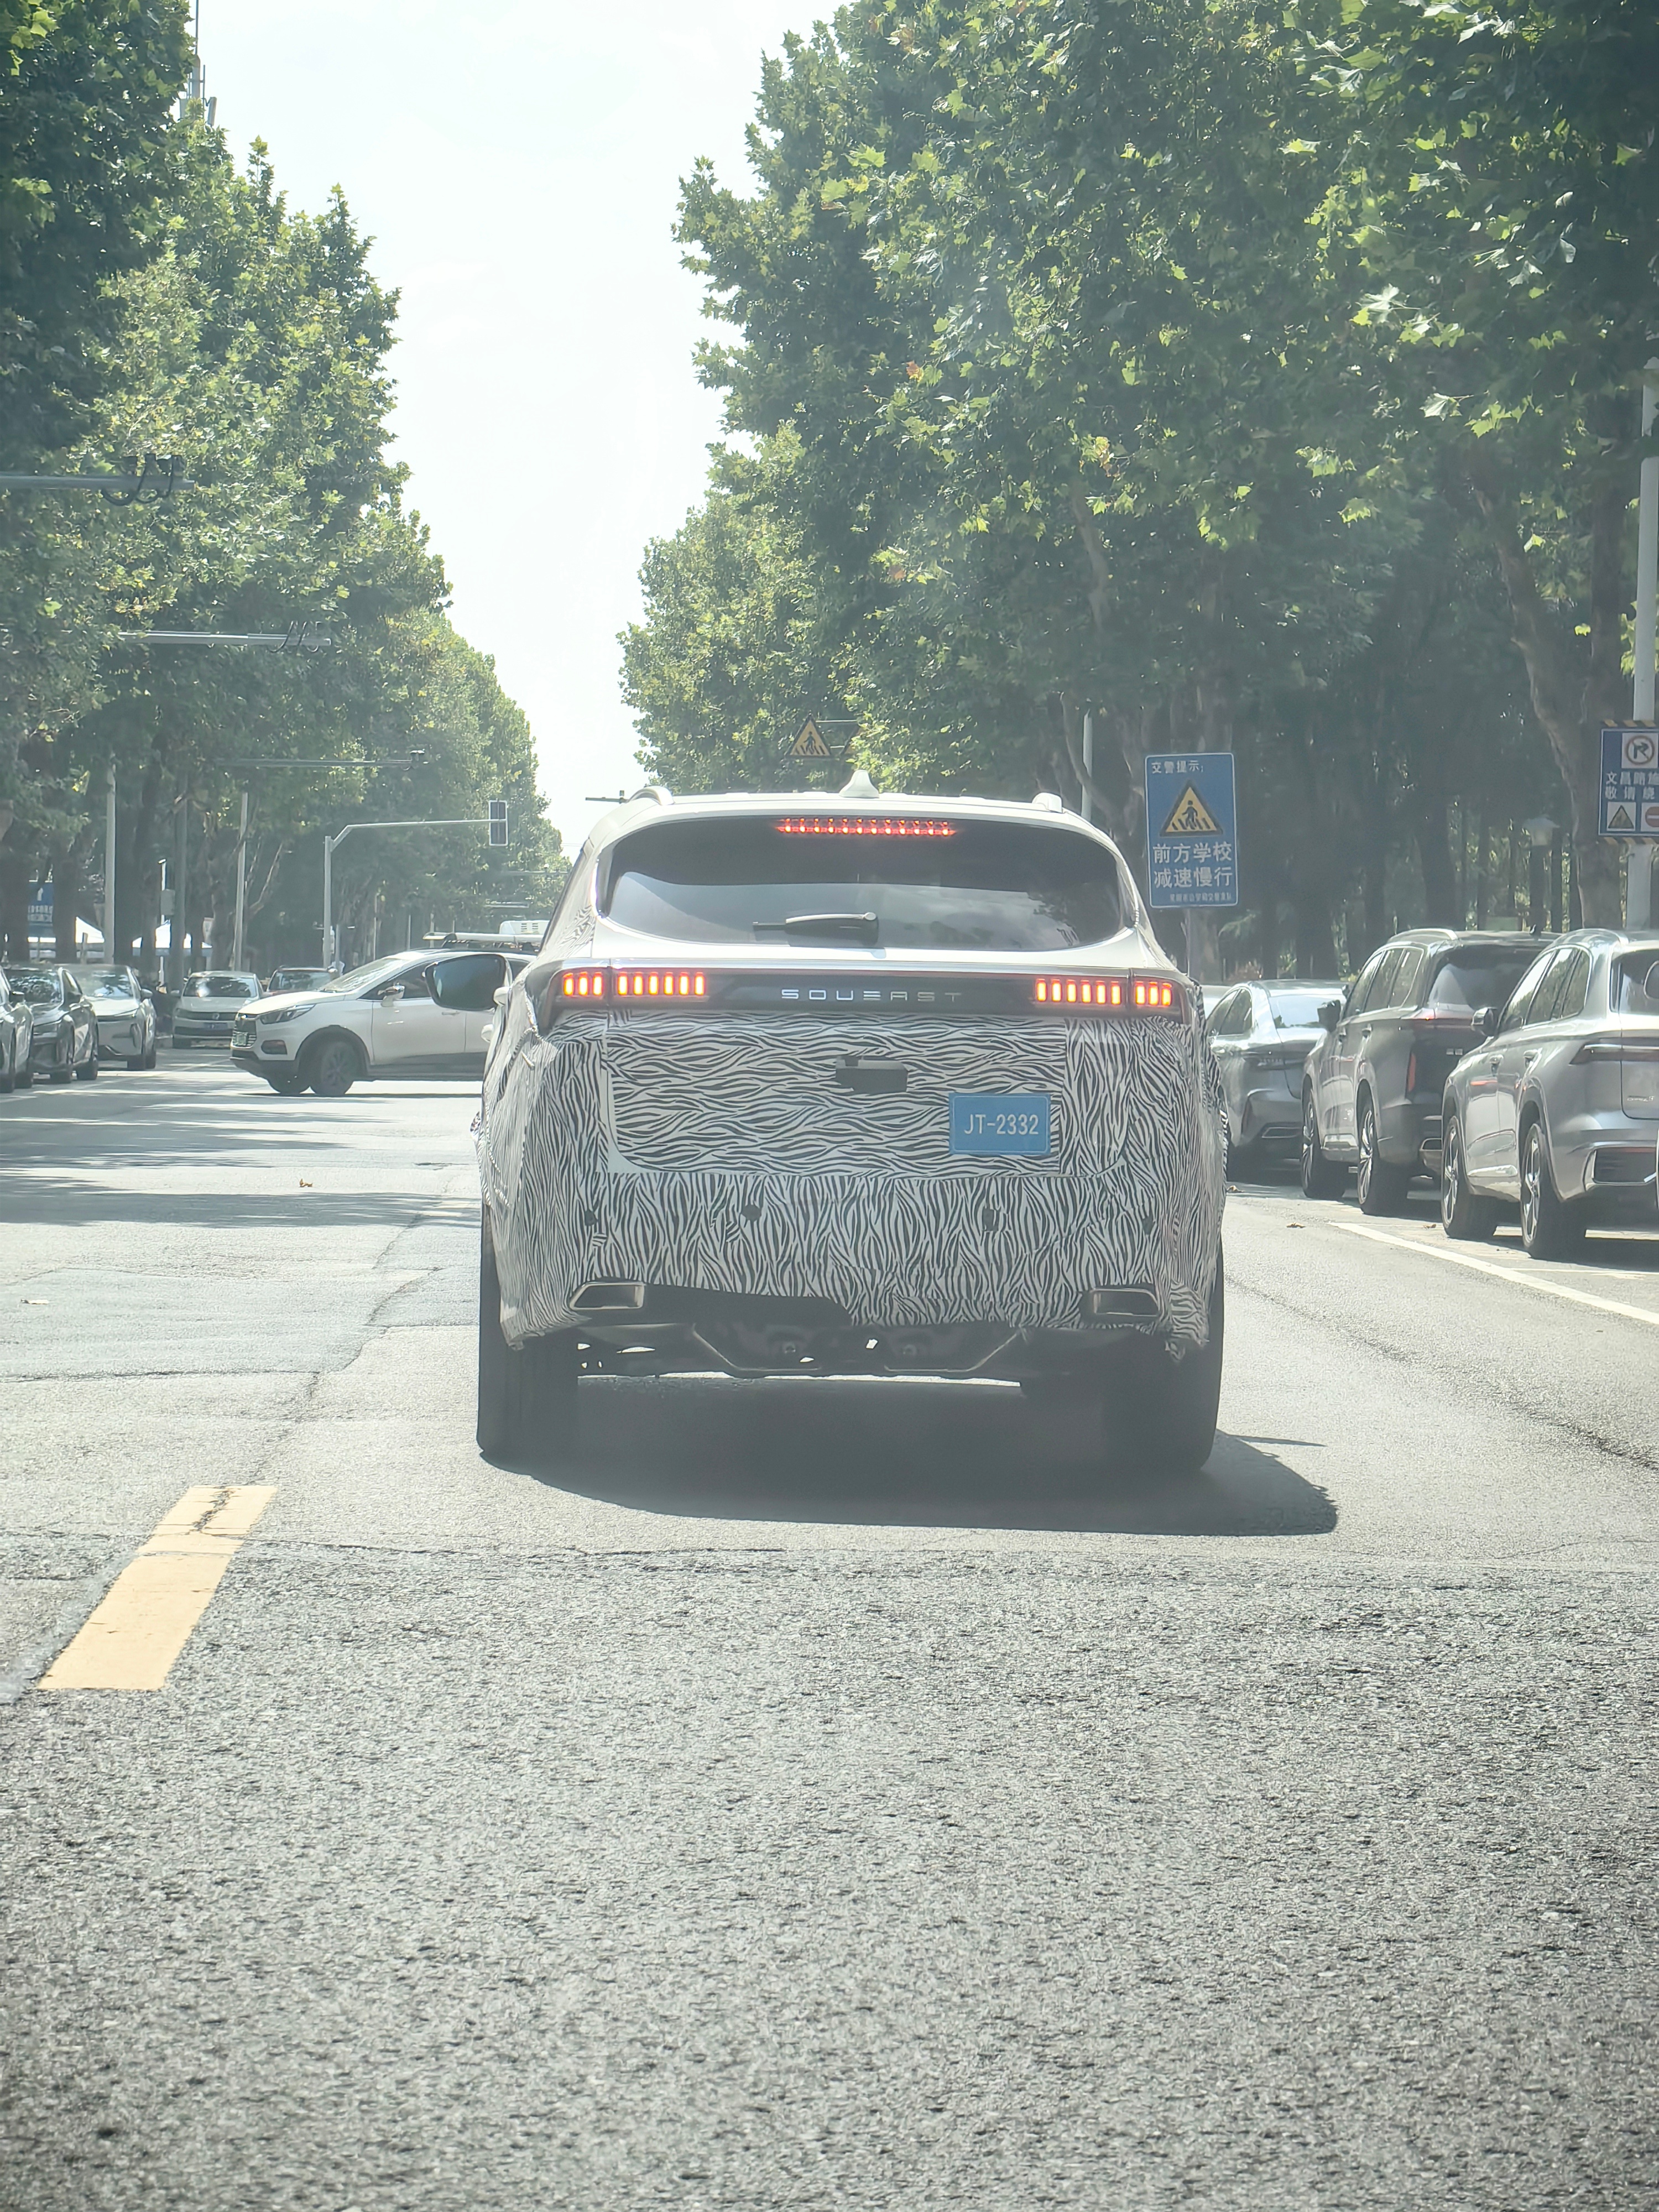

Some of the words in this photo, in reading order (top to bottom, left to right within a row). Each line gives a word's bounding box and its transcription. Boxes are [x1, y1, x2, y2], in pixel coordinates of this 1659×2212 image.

[1152, 842, 1233, 864] 前方学校
[1154, 866, 1233, 889] 减速慢行
[781, 989, 962, 1002] SOUEAST
[964, 1114, 1039, 1135] JT-2332
